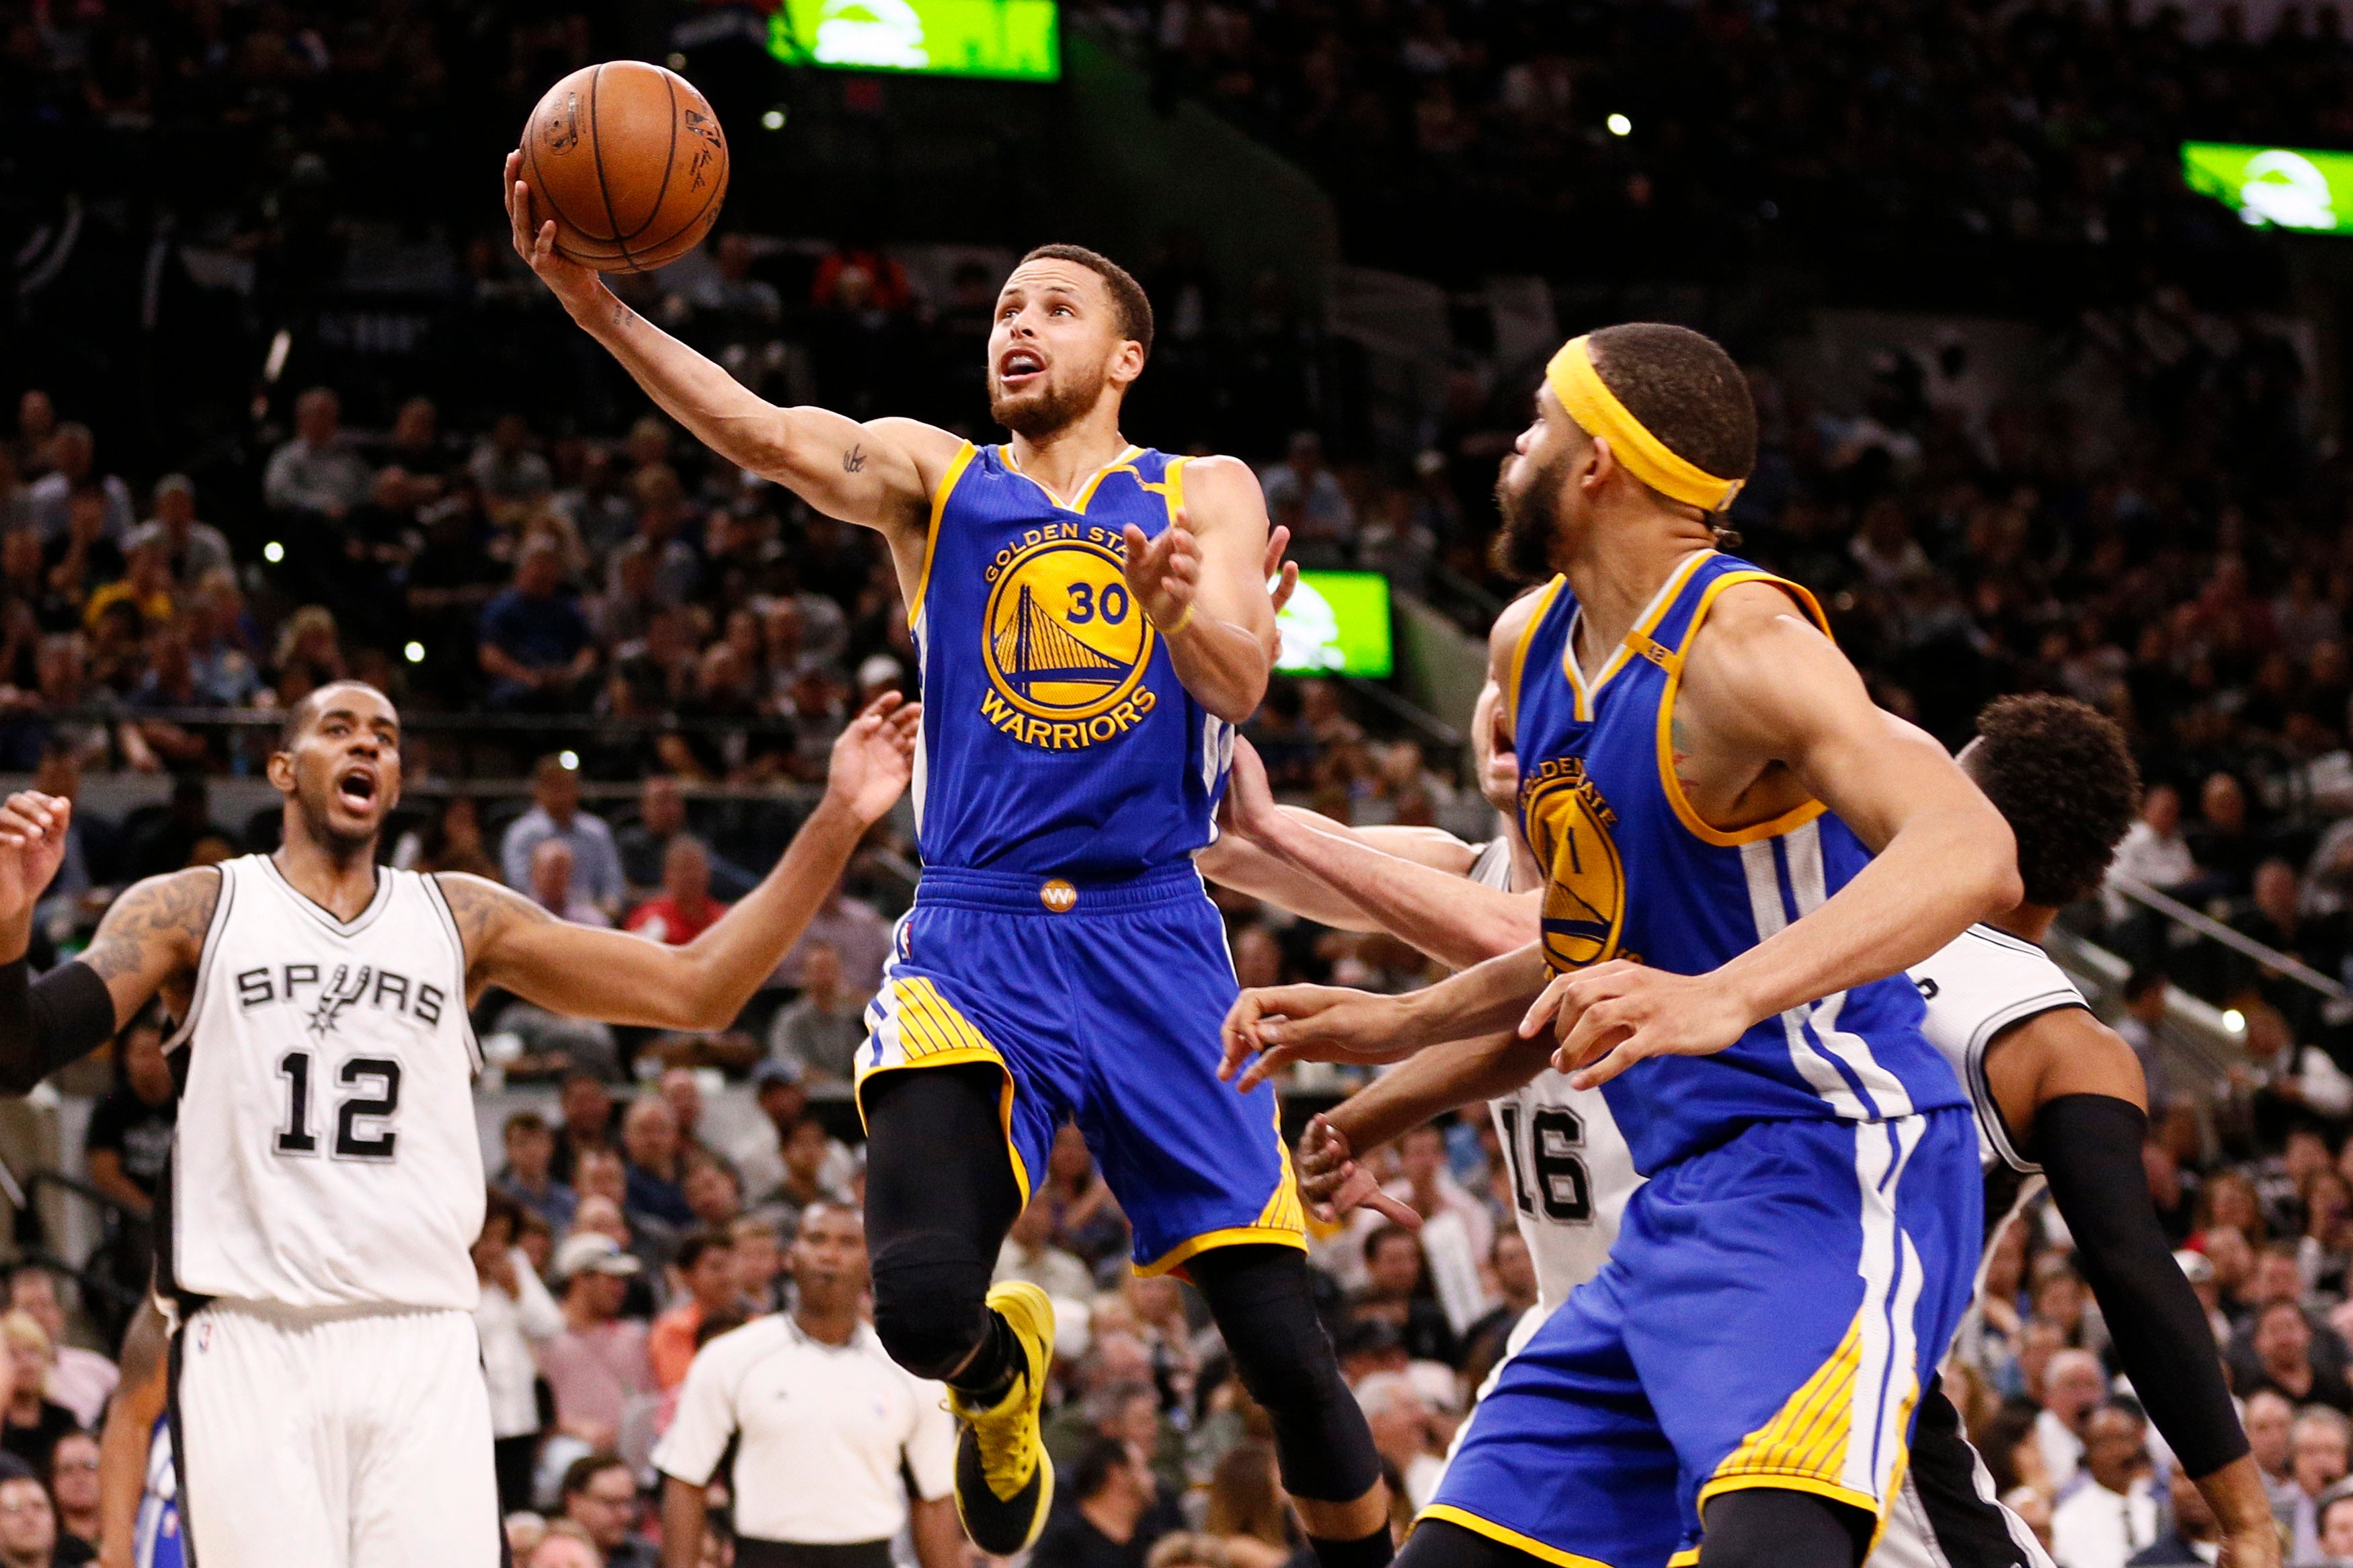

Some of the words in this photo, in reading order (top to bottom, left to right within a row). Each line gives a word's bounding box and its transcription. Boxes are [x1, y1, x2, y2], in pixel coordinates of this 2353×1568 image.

[984, 522, 1079, 583] GOLDEN
[1088, 526, 1129, 555] STA
[1066, 581, 1129, 626] 30
[980, 684, 1158, 750] WARRIORS
[1044, 887, 1072, 905] W
[236, 964, 446, 1038] SPURS
[272, 1046, 406, 1164] 12
[1501, 1102, 1596, 1226] 16
